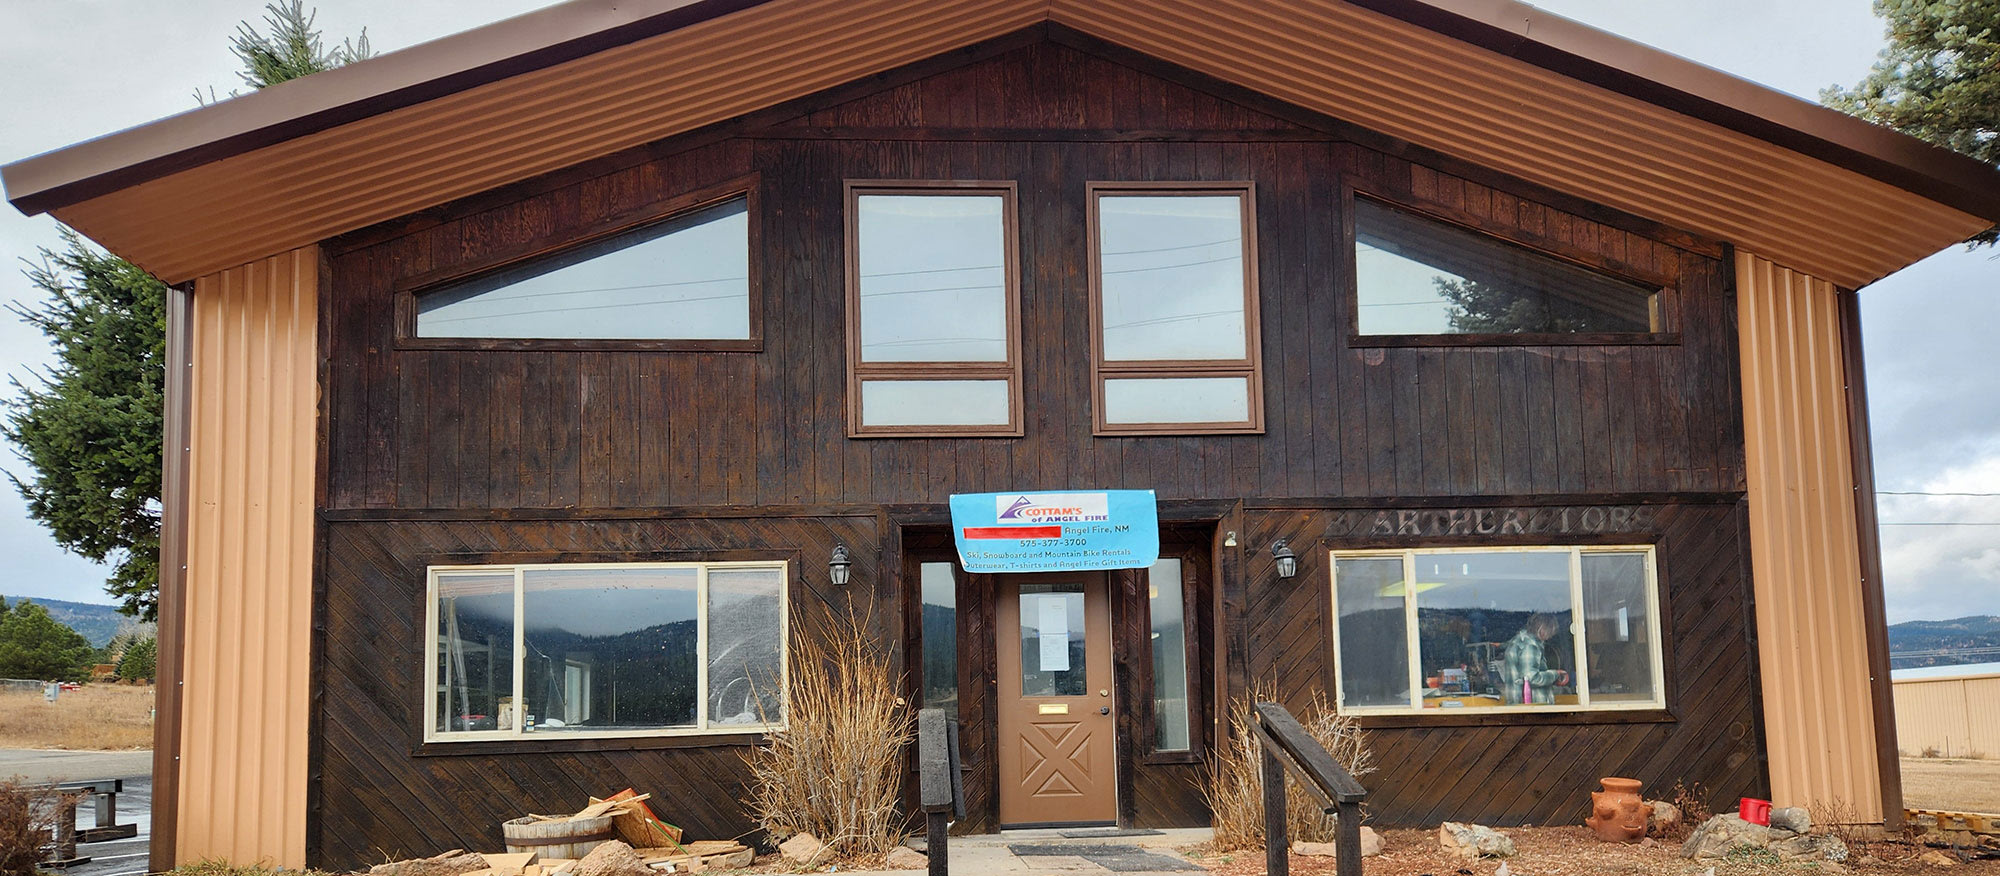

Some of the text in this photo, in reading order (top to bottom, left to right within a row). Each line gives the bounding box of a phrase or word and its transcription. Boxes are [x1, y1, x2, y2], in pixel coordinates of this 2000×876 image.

[1025, 507, 1083, 516] COTTAM'S
[1064, 525, 1130, 536] Angel Fire, NM
[1020, 538, 1087, 548] 575-377-3700
[966, 551, 982, 559] Ski,
[983, 551, 1027, 559] Snowboard
[1044, 550, 1082, 558] Mountain
[1059, 560, 1082, 568] Angel
